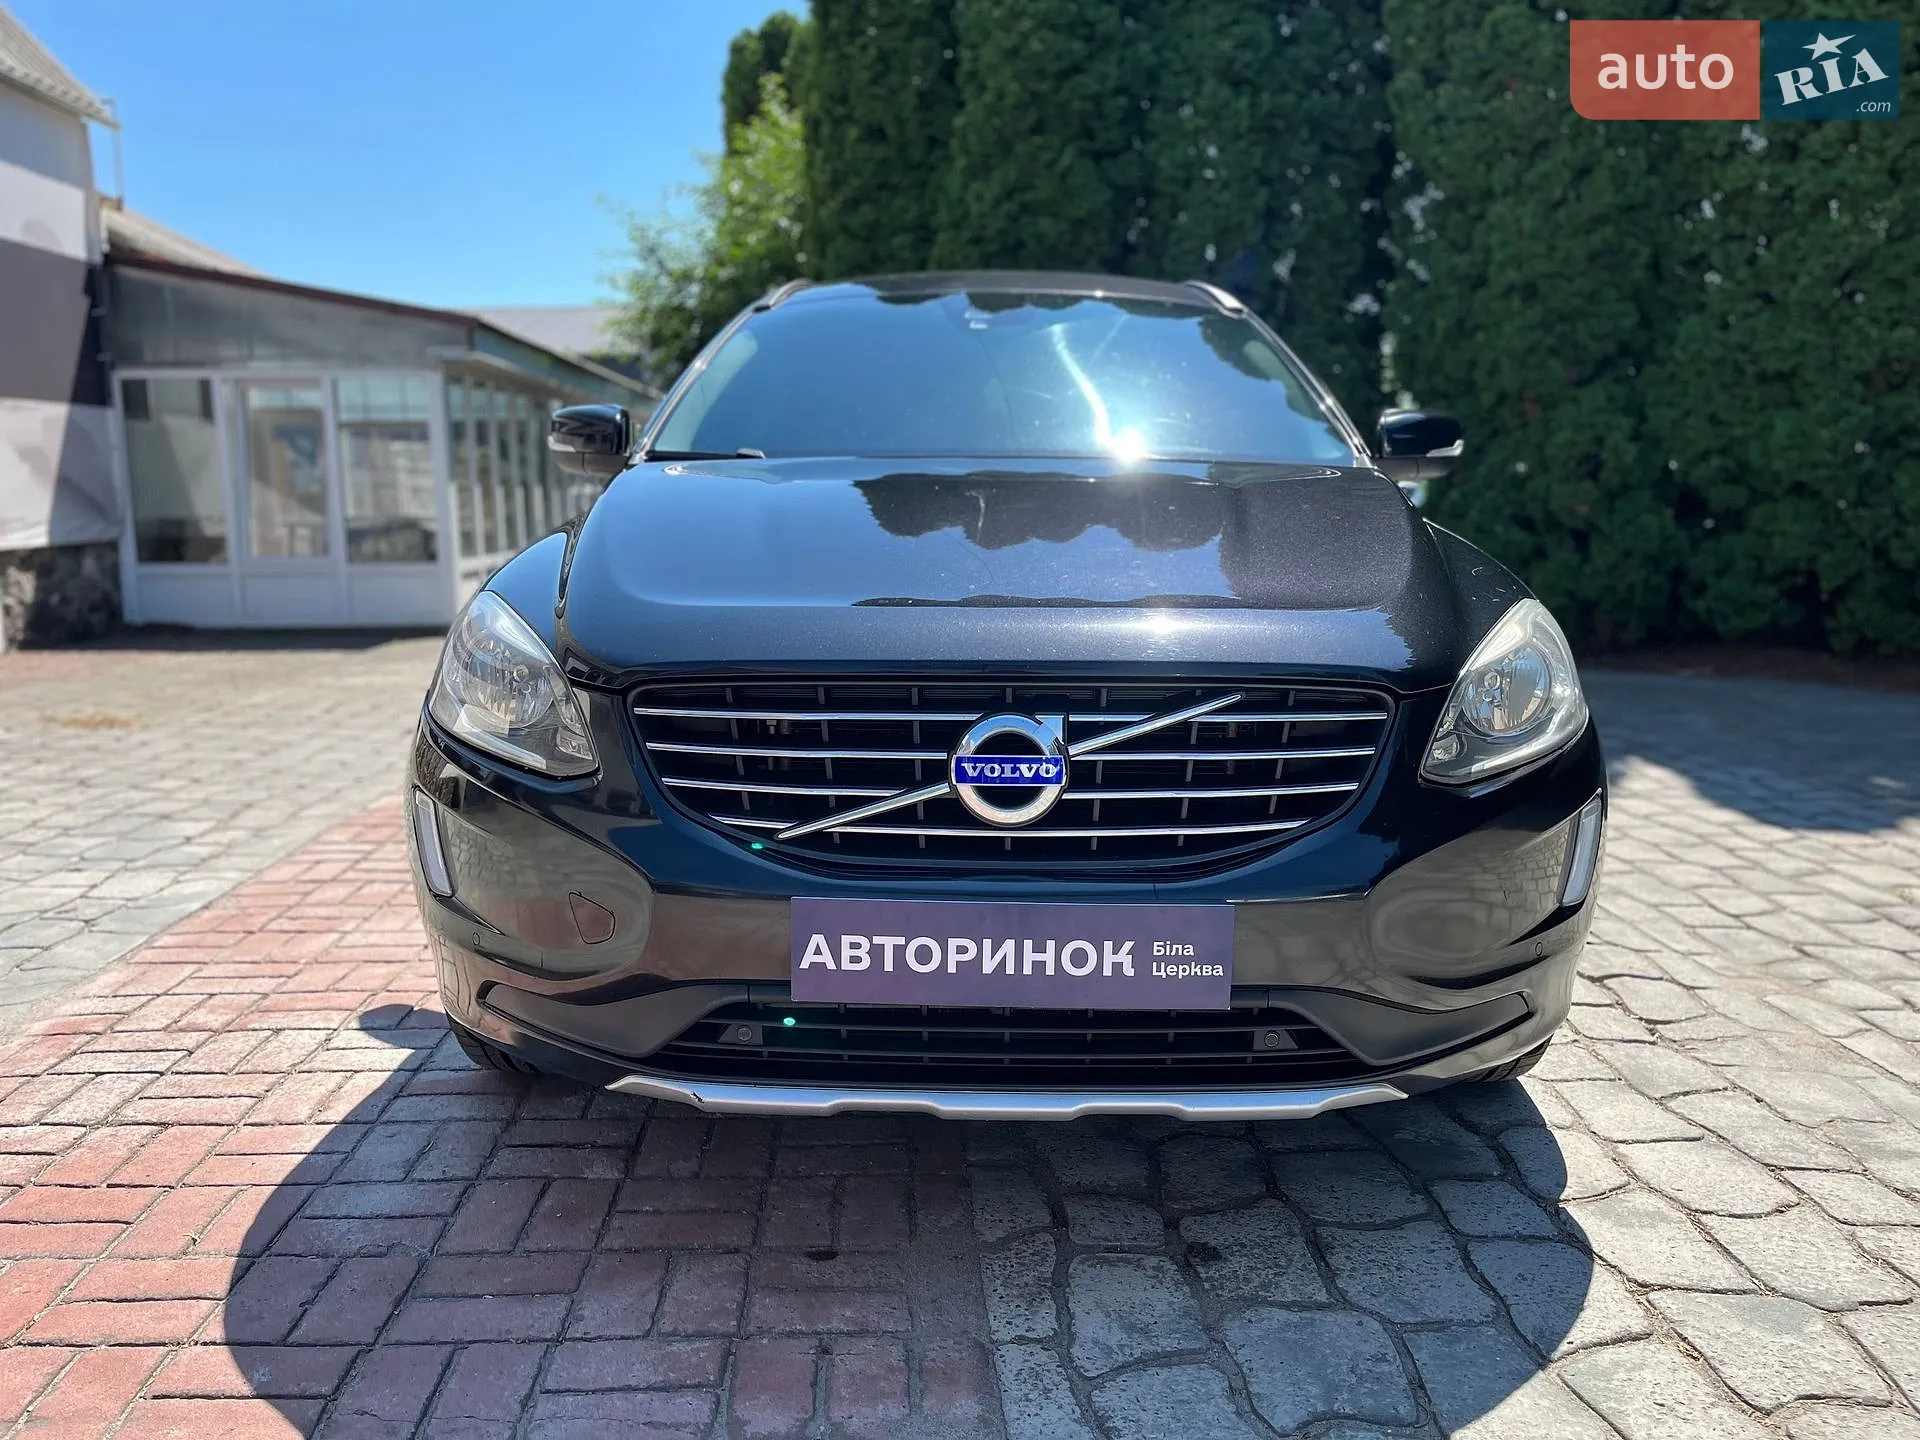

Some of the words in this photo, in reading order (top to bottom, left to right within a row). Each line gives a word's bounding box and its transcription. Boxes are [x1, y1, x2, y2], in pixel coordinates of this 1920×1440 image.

[960, 762, 1058, 778] VOLVO
[799, 933, 1136, 978] АВТОРИНОК
[1152, 940, 1195, 957] Біла
[1151, 961, 1225, 980] Церква
